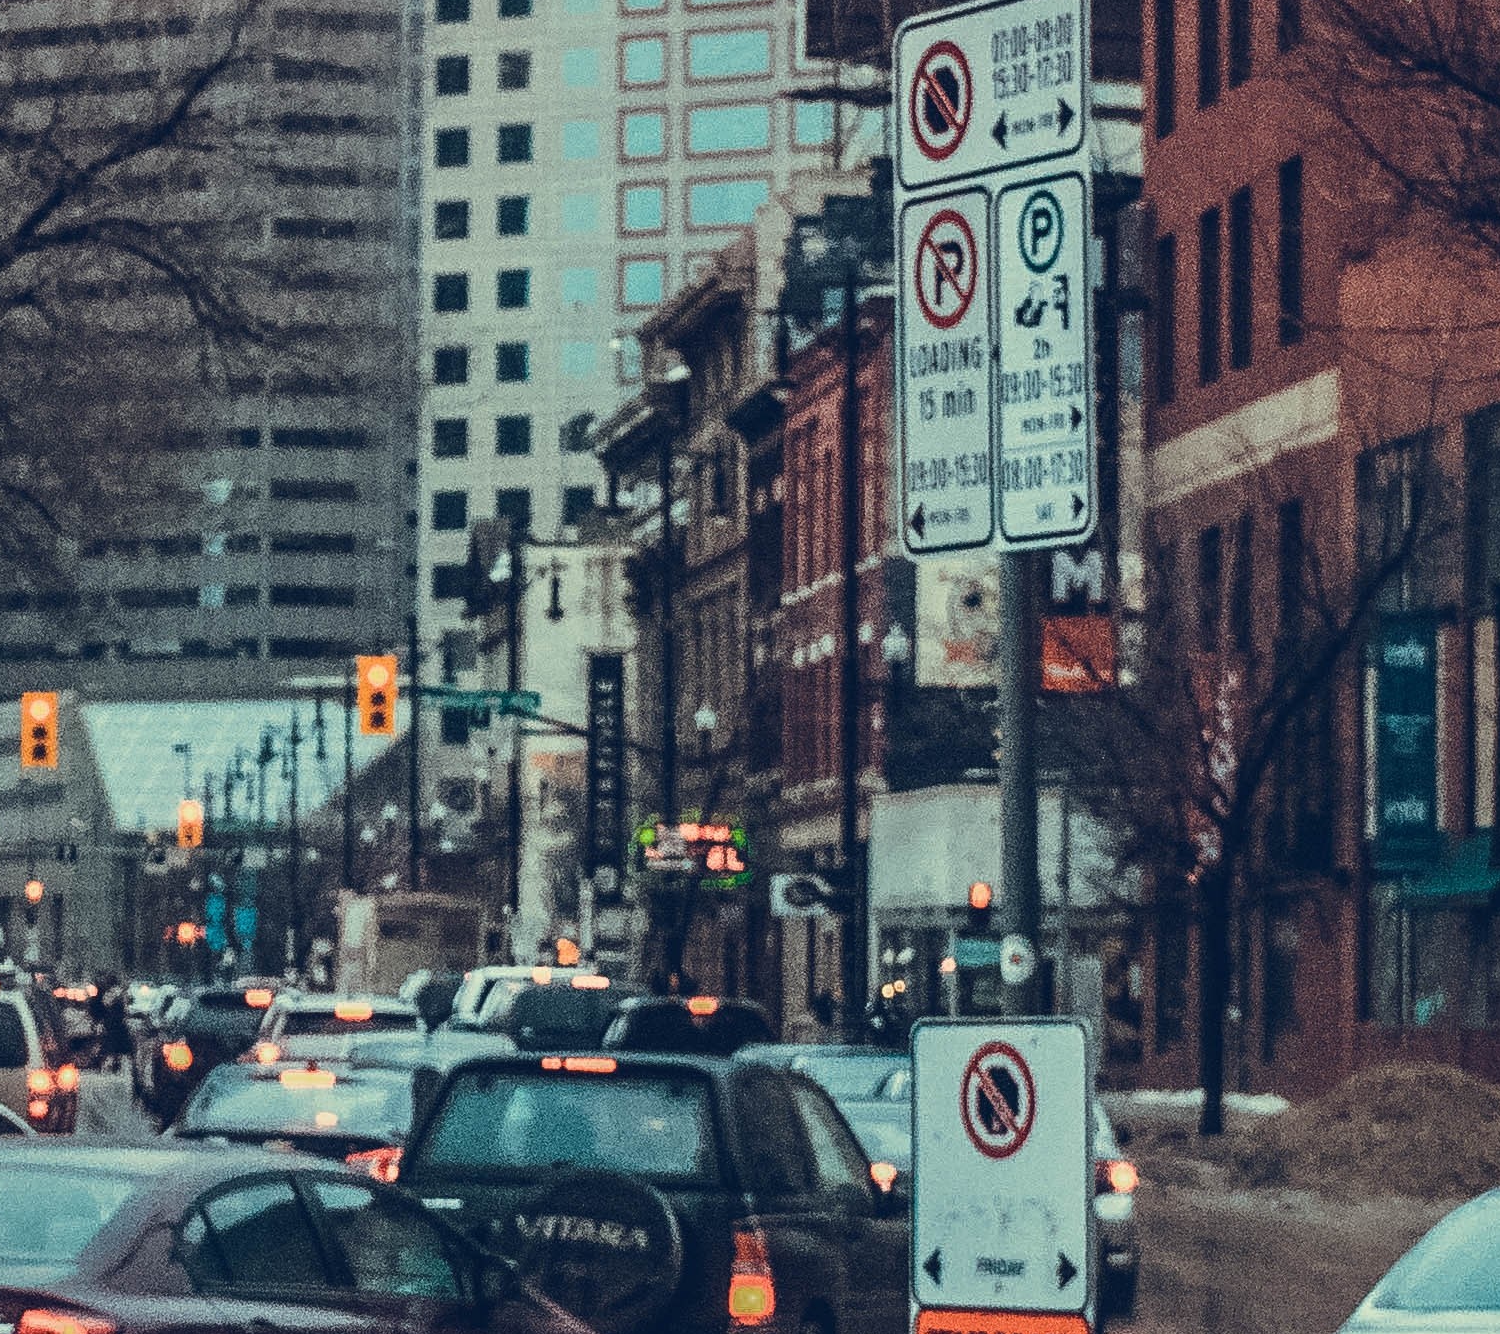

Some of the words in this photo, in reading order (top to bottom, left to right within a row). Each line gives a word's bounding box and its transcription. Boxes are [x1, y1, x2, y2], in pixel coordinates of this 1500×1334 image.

[909, 336, 983, 378] LOADING
[1033, 337, 1051, 360] 2h
[514, 1213, 649, 1251] VITARA
